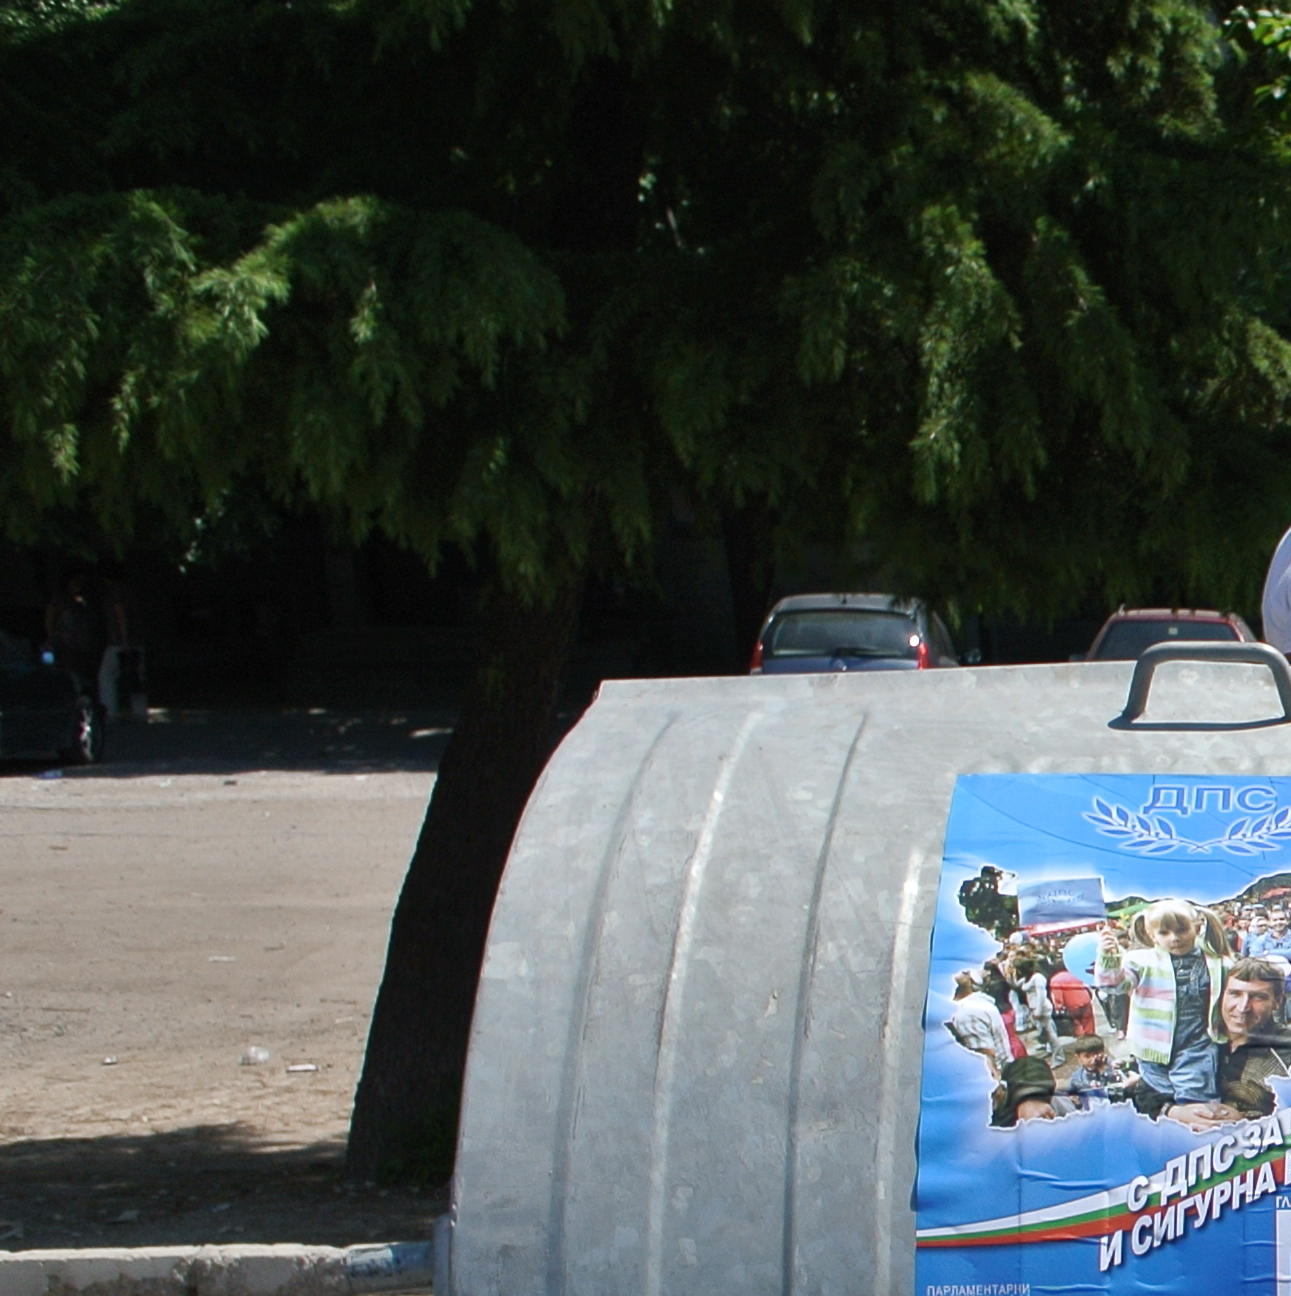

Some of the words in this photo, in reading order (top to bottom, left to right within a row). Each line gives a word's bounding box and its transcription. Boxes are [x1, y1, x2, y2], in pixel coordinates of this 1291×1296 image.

[1143, 784, 1277, 815] ДПС
[1125, 1174, 1150, 1213] С
[1162, 1134, 1237, 1204] ДПС
[1241, 1119, 1283, 1159] ЗА
[1099, 1233, 1123, 1272] И
[1130, 1158, 1277, 1258] СИГУРНА
[927, 1284, 1030, 1296] ПАРЛАМЕНТАРНИ
